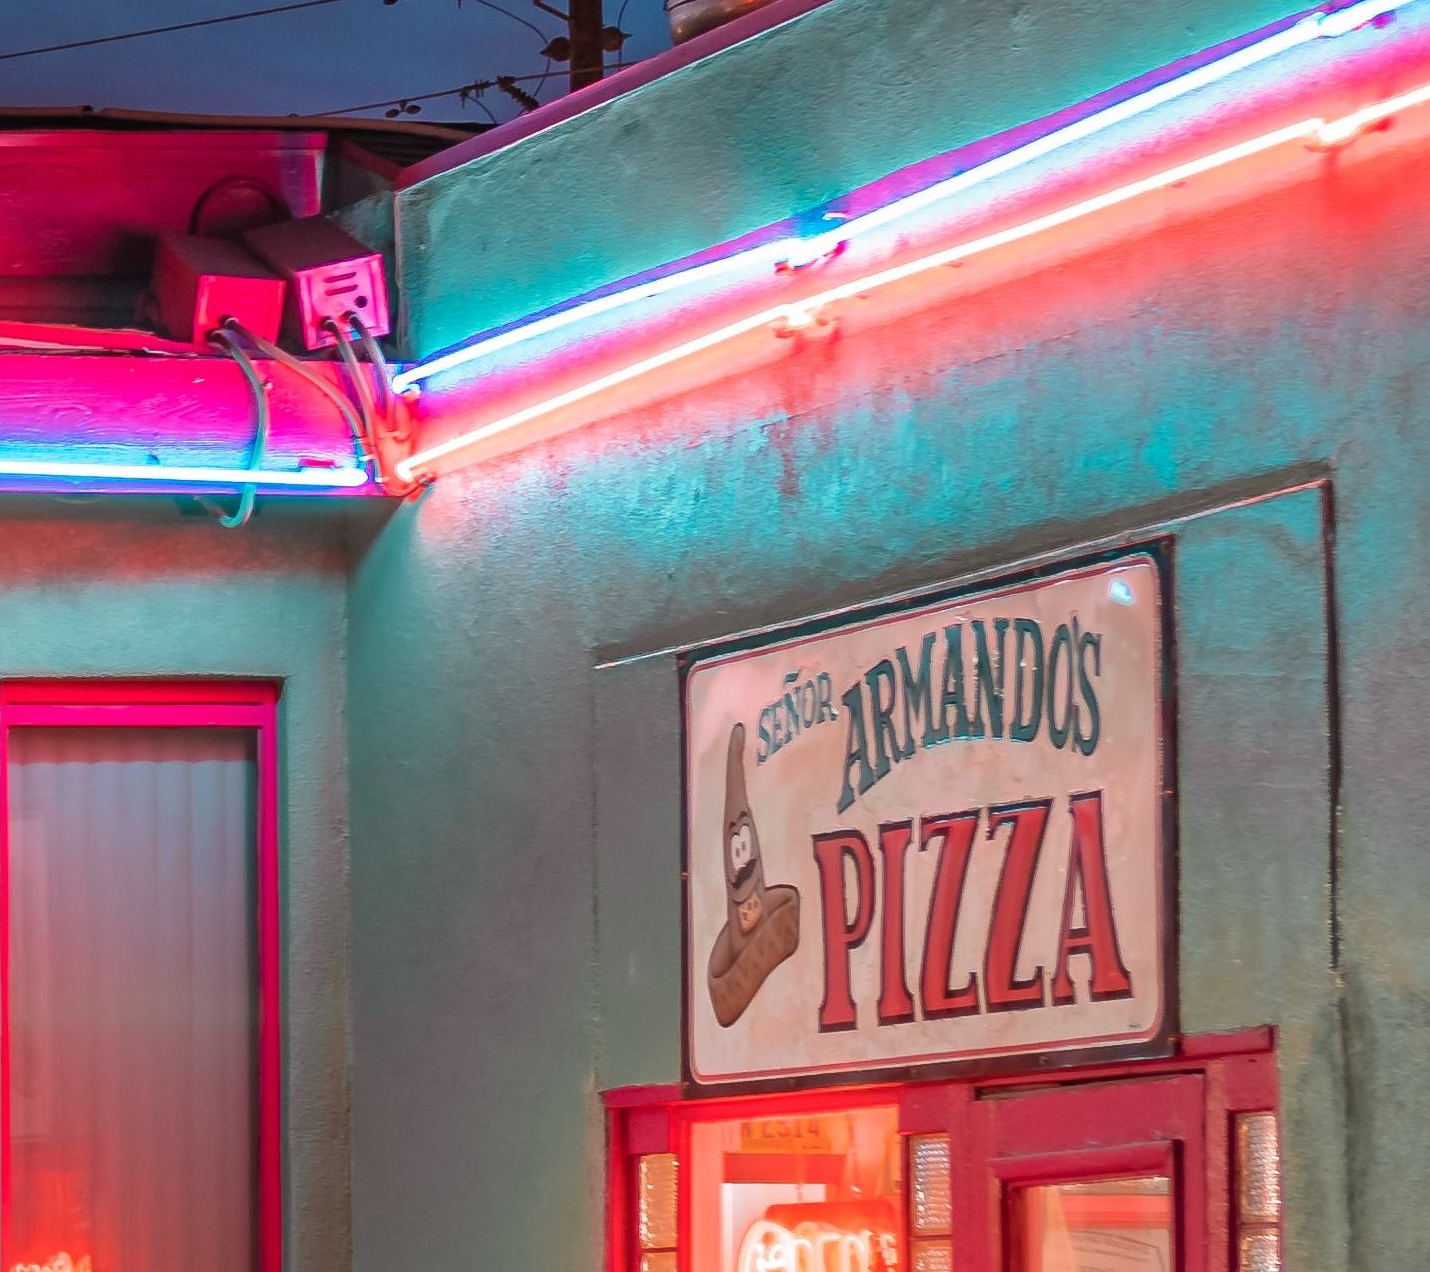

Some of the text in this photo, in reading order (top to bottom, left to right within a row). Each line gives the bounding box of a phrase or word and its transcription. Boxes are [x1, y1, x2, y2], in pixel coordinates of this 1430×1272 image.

[756, 616, 1102, 815] SEÑOR ARMANDO'S
[811, 789, 1132, 1033] PIZZA
